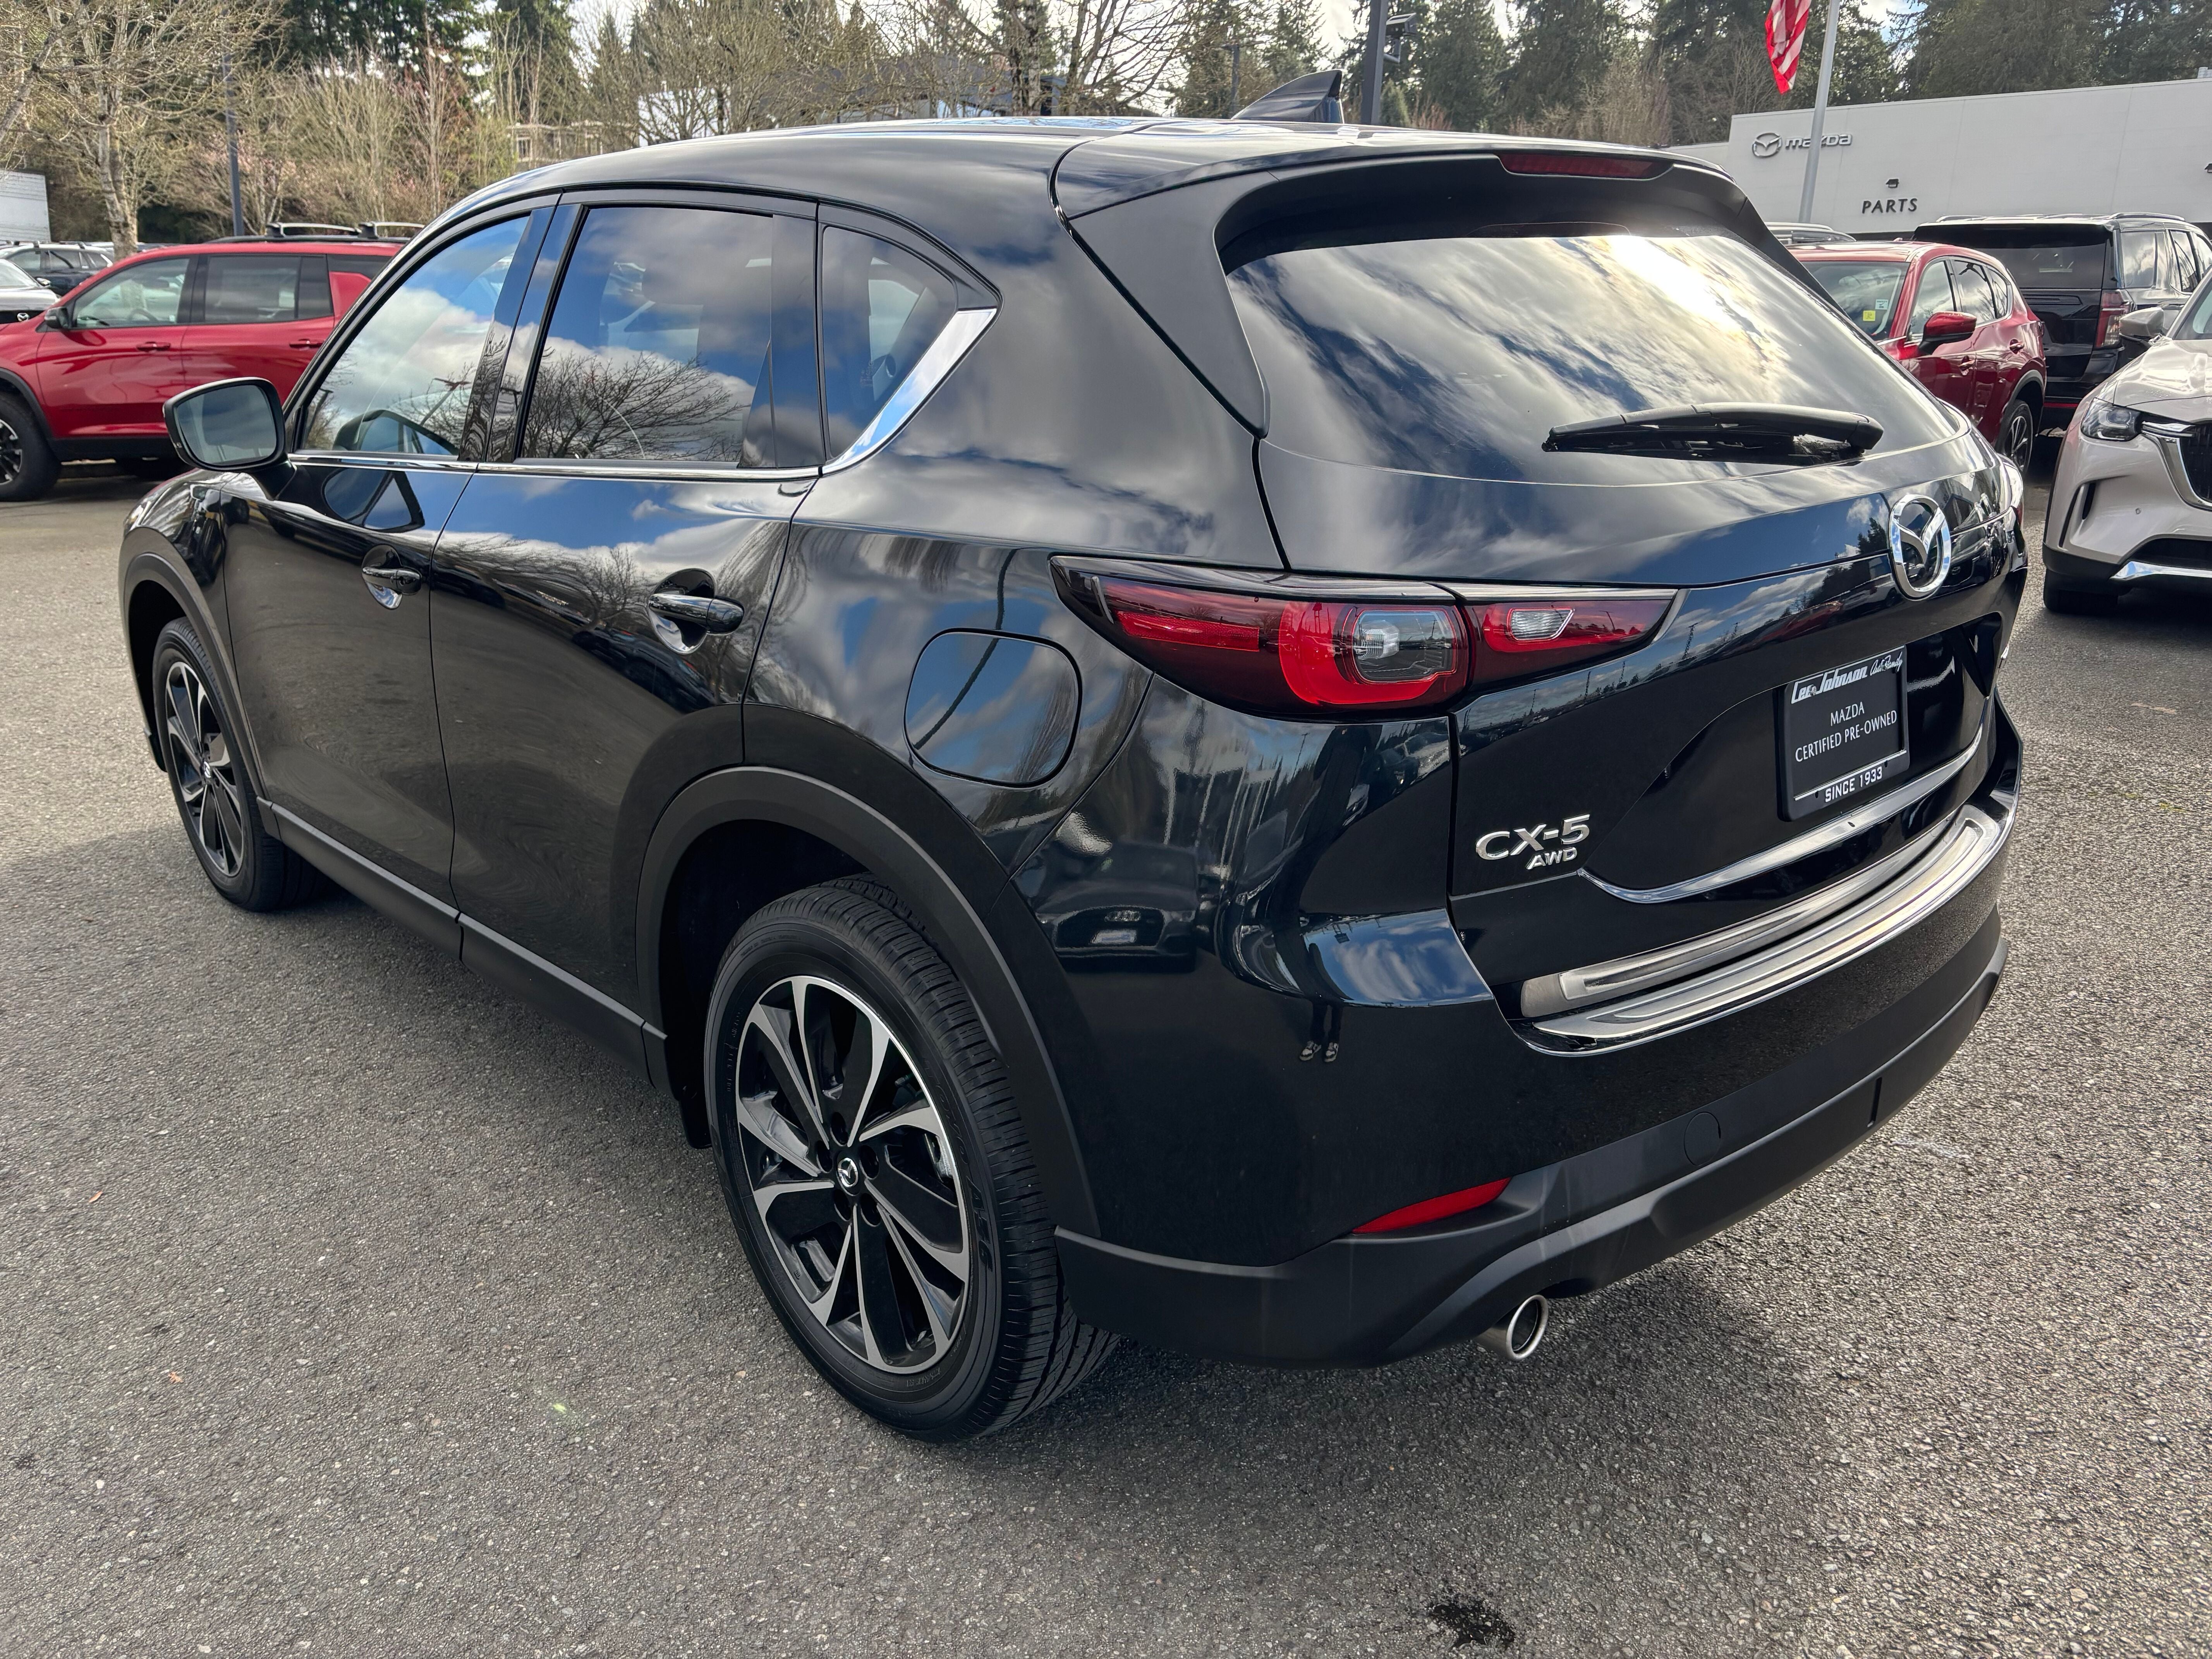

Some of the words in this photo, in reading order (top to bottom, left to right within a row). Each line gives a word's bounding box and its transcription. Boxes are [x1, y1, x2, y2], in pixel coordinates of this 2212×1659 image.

[1862, 198, 1918, 214] PARTS
[1815, 666, 1868, 696] Johnson
[1830, 701, 1865, 726] MAZDA
[1795, 732, 1841, 762] CERTIFIED
[1844, 709, 1897, 743] PRE-OWNED
[1825, 778, 1855, 803] SINCE
[1860, 766, 1883, 788] 1933
[1475, 814, 1590, 860] CX-5
[1526, 847, 1578, 870] AWD
[922, 1056, 969, 1165] TOYO
